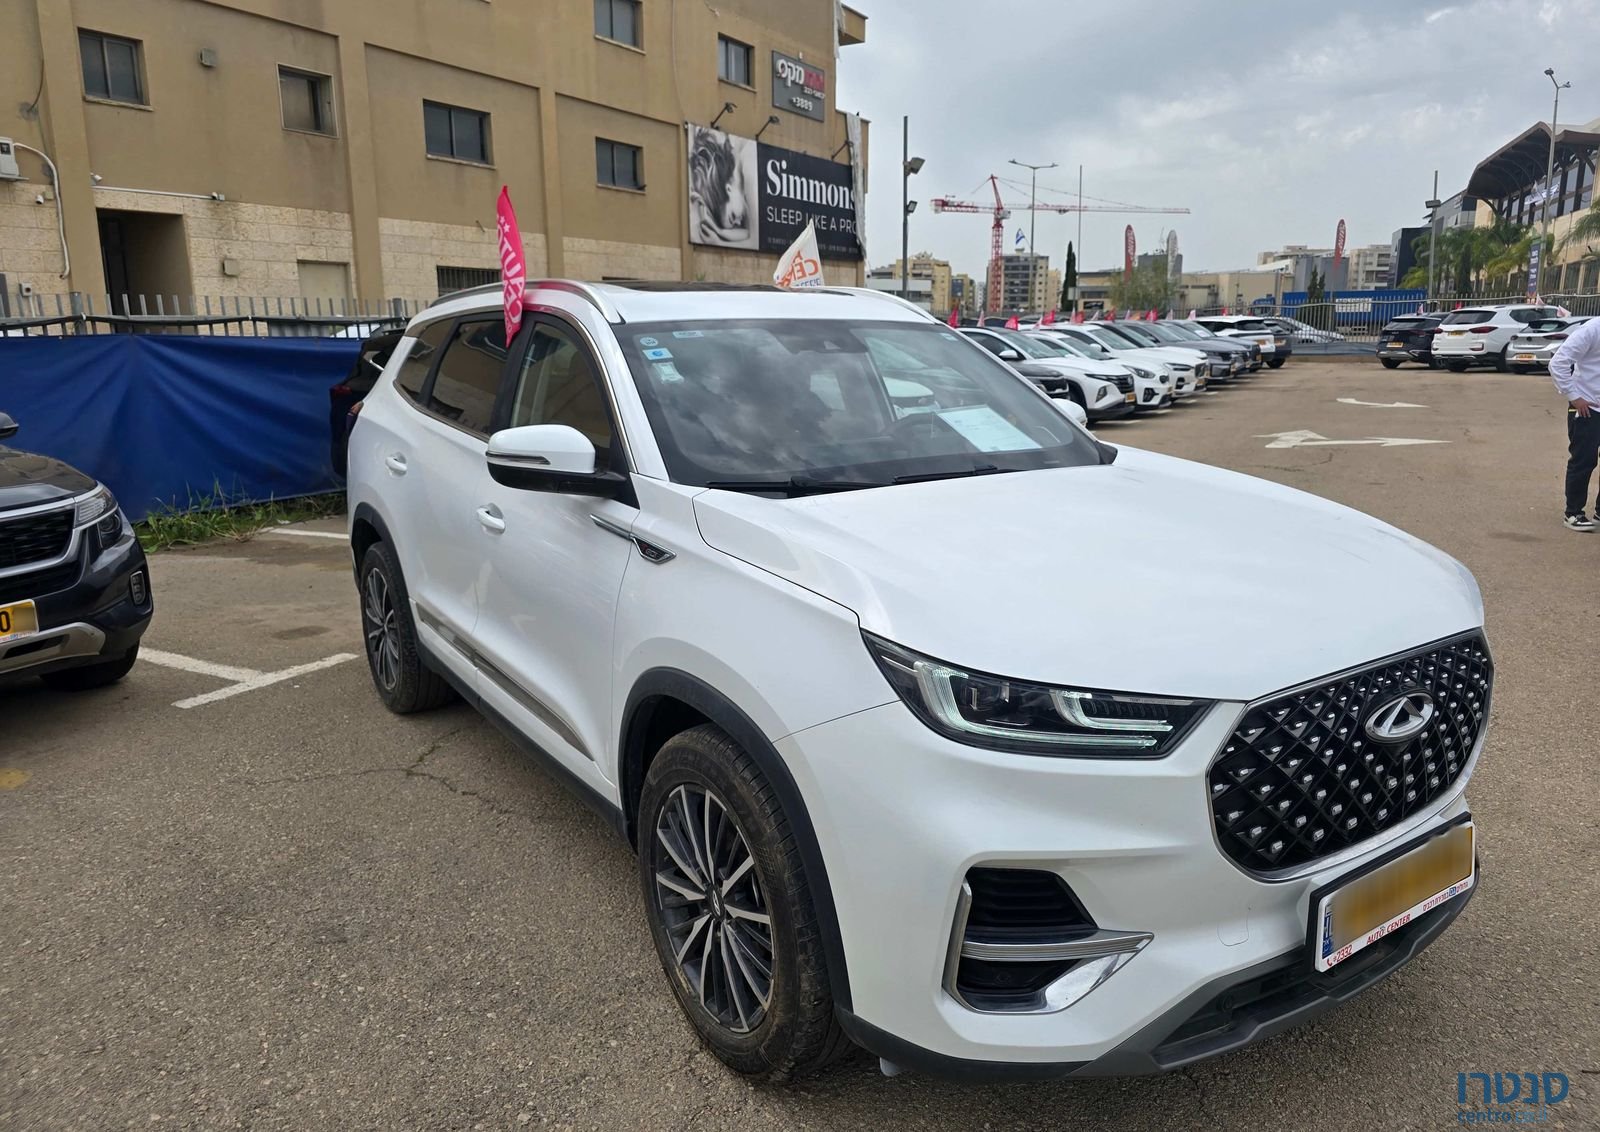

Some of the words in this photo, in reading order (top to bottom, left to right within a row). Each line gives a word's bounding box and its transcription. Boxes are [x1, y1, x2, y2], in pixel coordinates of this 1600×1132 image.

[767, 206, 803, 225] SLEEP
[829, 217, 837, 231] A
[1366, 928, 1385, 944] AUTO
[1386, 913, 1411, 932] CENTER
